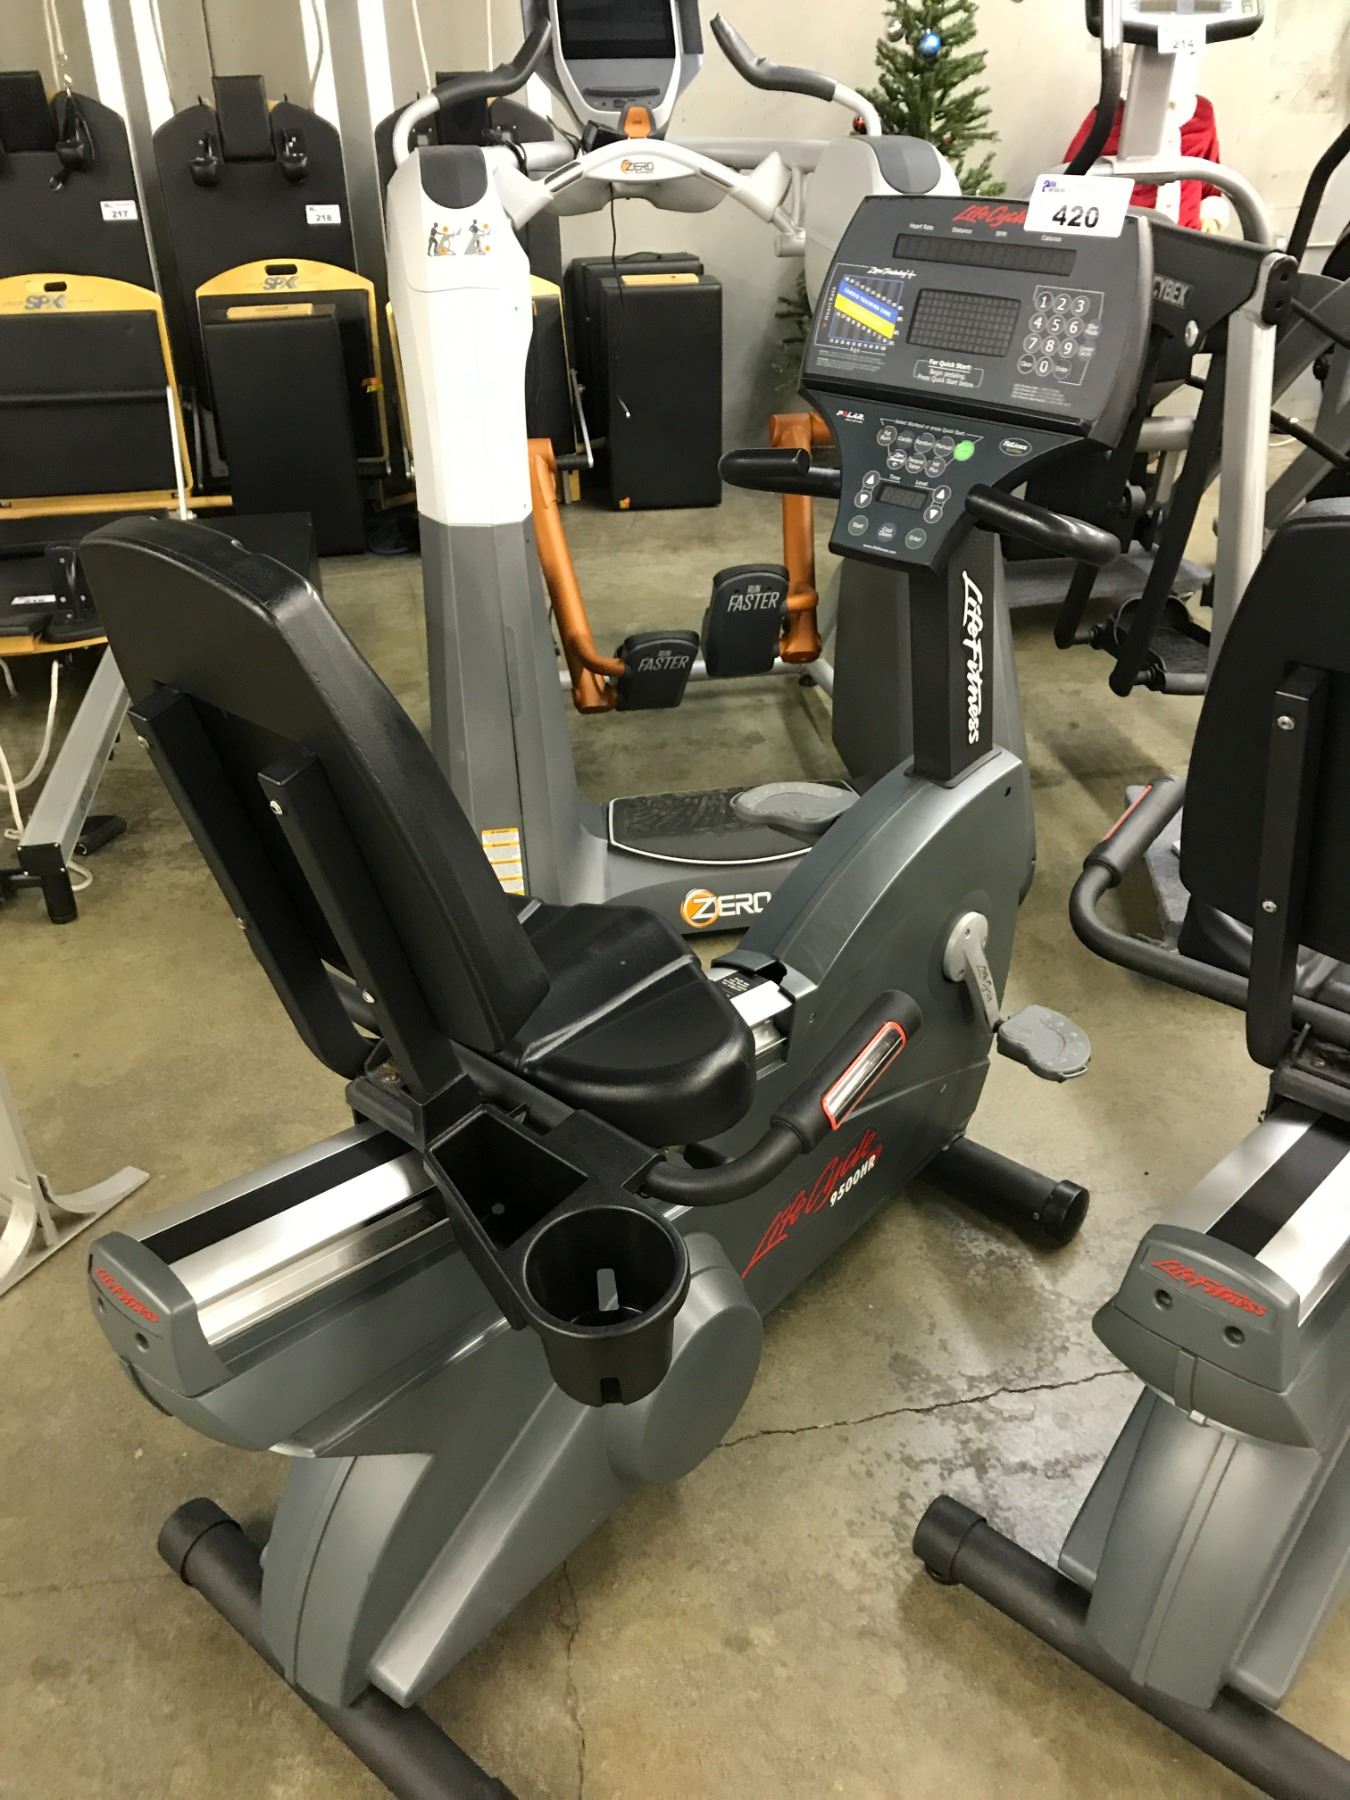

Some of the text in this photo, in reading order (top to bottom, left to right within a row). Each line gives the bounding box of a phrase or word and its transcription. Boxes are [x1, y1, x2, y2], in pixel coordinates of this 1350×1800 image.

[621, 160, 654, 173] ZERO
[111, 209, 128, 219] 217
[315, 213, 332, 222] 218
[1052, 205, 1100, 228] 420
[1039, 295, 1085, 313] 1 2 3
[1033, 316, 1043, 329] 4
[1051, 318, 1061, 332] 5
[1069, 320, 1079, 334] 6
[1028, 337, 1038, 350] 7
[1045, 339, 1055, 353] 8
[1063, 341, 1073, 355] 9
[928, 358, 939, 366] For
[939, 360, 955, 368] Quick
[1039, 360, 1049, 373] 0
[836, 409, 865, 420] POLAR
[727, 591, 780, 613] FASTER
[637, 655, 690, 672] FASTER
[688, 890, 773, 922] ZERO
[830, 1153, 877, 1208] 9500HR
